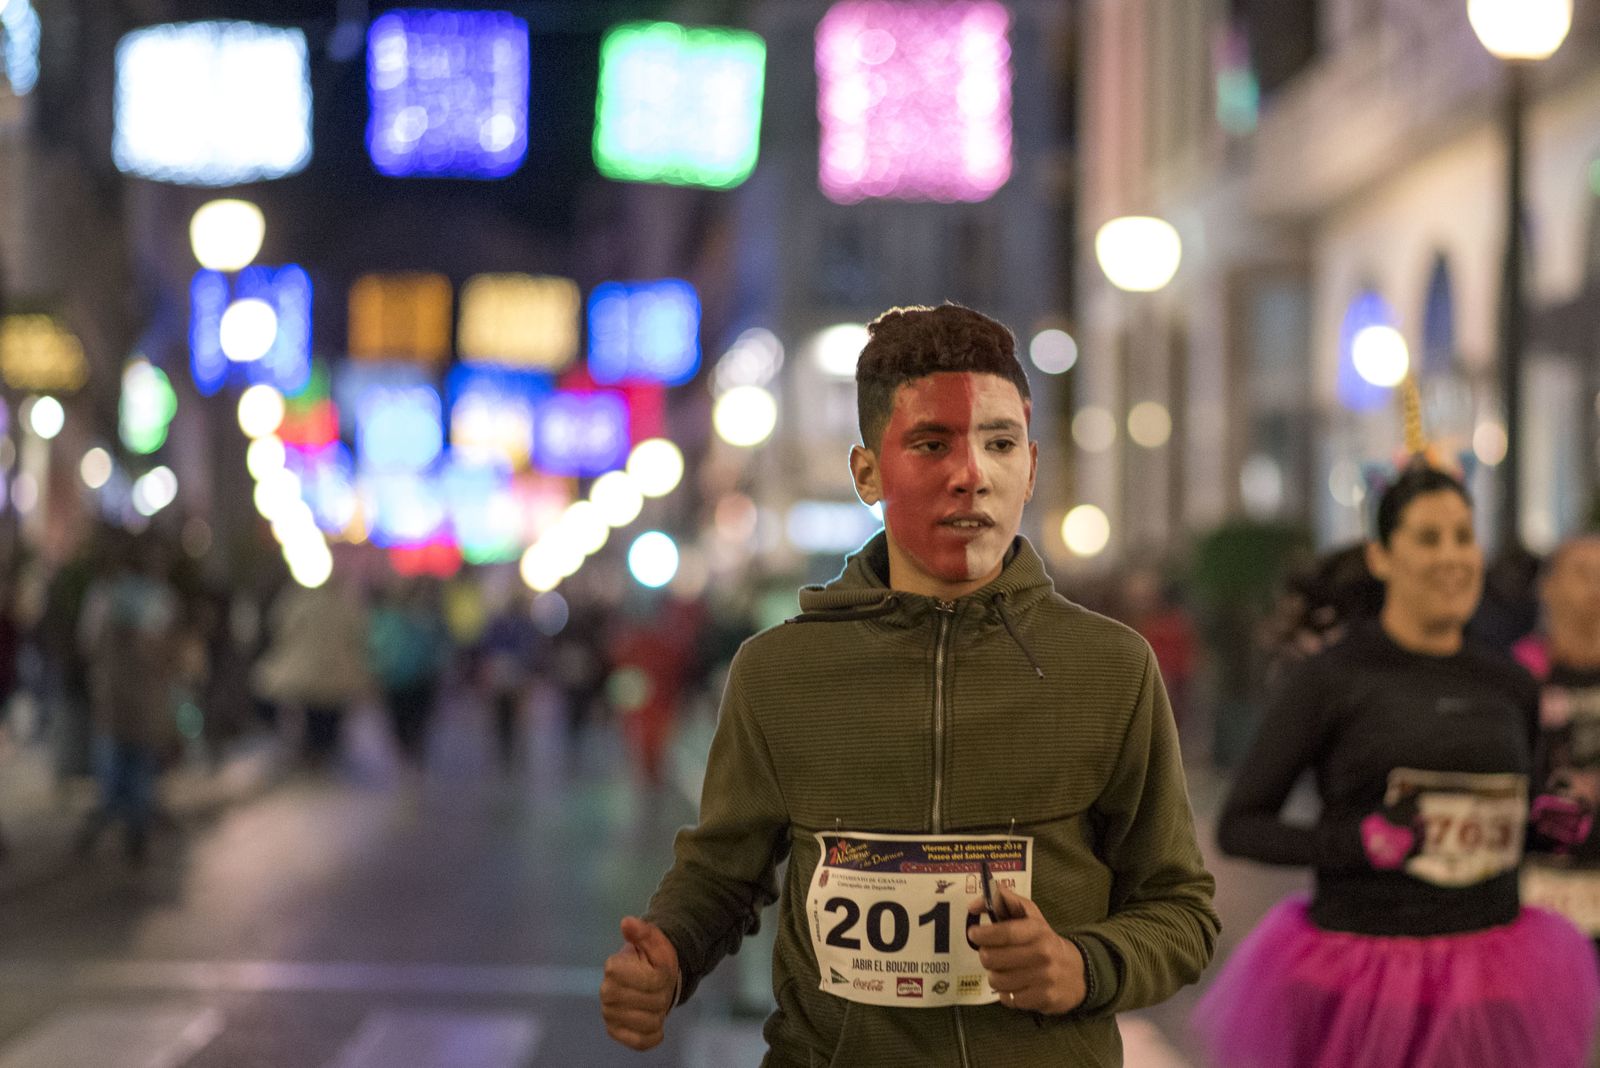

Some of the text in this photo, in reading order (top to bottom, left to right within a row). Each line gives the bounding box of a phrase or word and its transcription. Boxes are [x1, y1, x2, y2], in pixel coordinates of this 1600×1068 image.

[922, 844, 953, 853] Viernes,
[954, 844, 964, 852] 21
[965, 843, 1001, 851] diciembre
[928, 852, 950, 860] Paseo
[952, 852, 964, 860] del
[990, 851, 1022, 859] Granada
[852, 957, 950, 974] JABIR EL BOUZIDI (2003)
